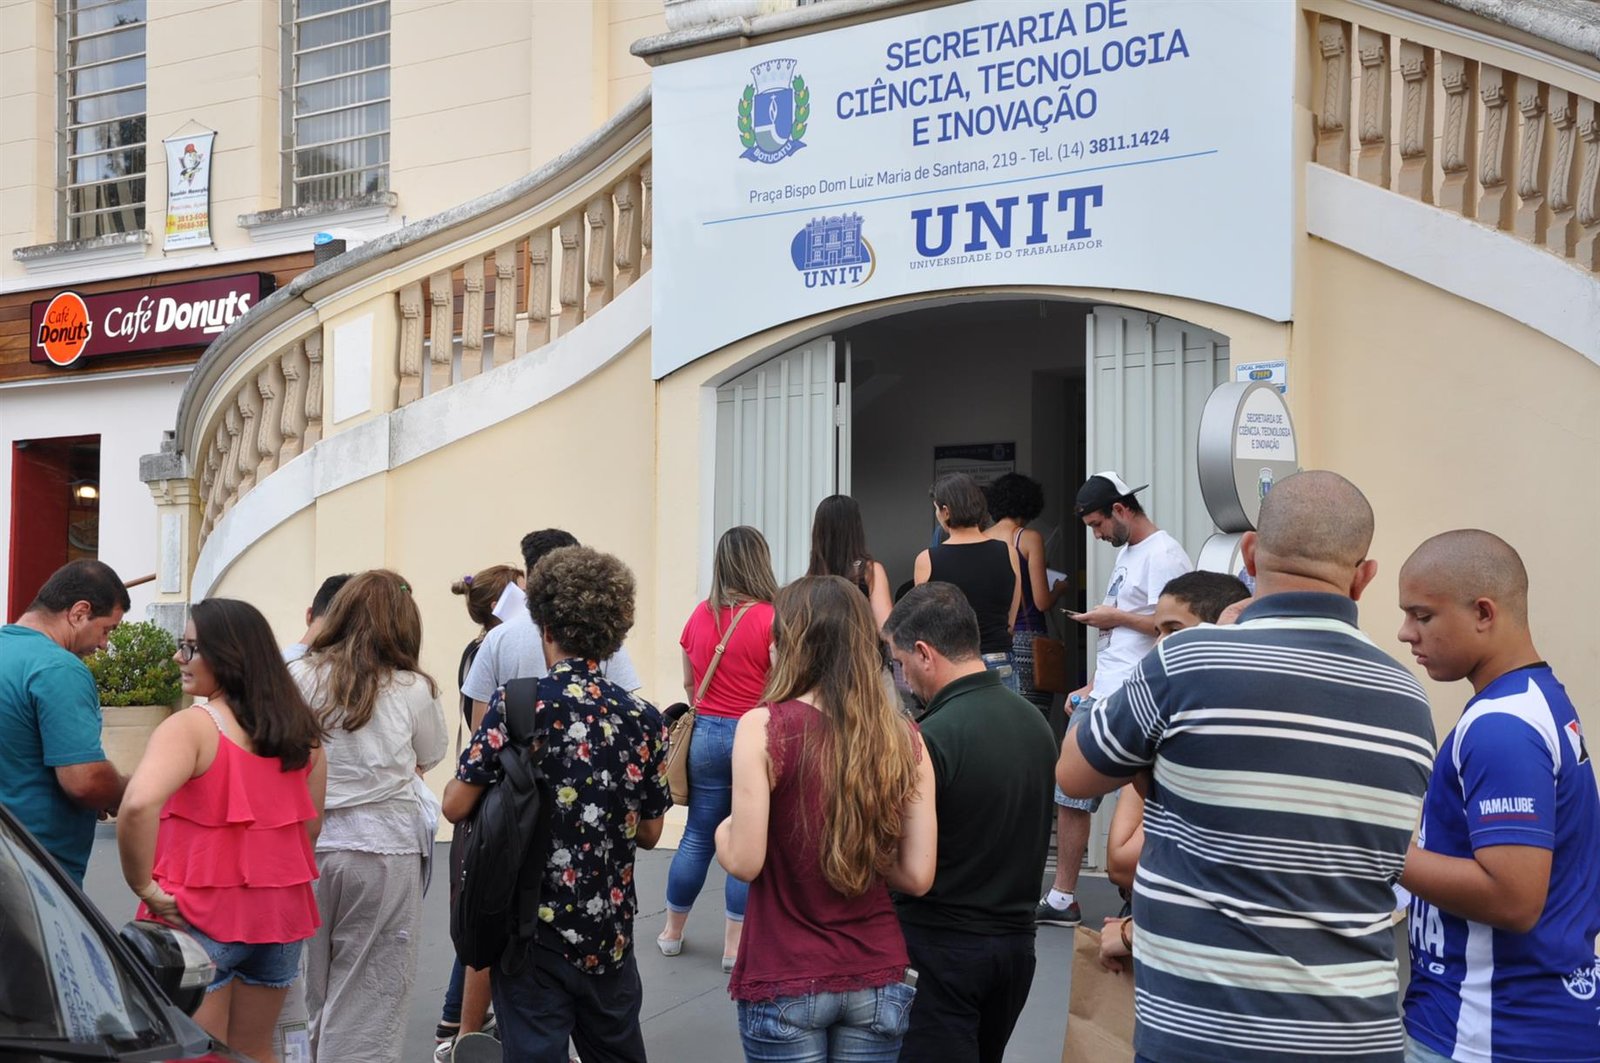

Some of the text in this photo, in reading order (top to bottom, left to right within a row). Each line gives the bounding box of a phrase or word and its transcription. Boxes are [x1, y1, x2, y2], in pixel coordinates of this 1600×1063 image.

[886, 0, 1128, 72] SECRETARIA DE
[836, 28, 1190, 120] CIÊNCIA, TECNOLOGIA
[912, 84, 1098, 146] E INOVAÇÃO
[753, 142, 792, 162] BOTUCATU
[750, 187, 782, 204] Praça
[785, 182, 816, 199] Bispo
[819, 179, 846, 194] Dom
[850, 174, 874, 189] Luiz
[877, 170, 911, 185] Maria
[914, 165, 930, 180] de
[933, 159, 989, 178] Santana,
[992, 151, 1017, 169] 219
[1029, 147, 1053, 163] Tel.
[1057, 141, 1084, 162] (14)
[1089, 128, 1170, 154] 3811.1424
[910, 185, 1104, 257] UNIT
[909, 239, 1103, 271] UNIVERSIDADE DO TRABALHADOR
[803, 265, 863, 289] UNIT
[48, 306, 70, 325] Café
[104, 290, 251, 342] Café Donuts
[39, 321, 91, 345] Donuts
[1246, 413, 1283, 424] SECRETARIA DE
[1261, 426, 1291, 437] TECNOLOGIA
[1251, 440, 1255, 449] E
[1479, 796, 1535, 815] YAMALUBE
